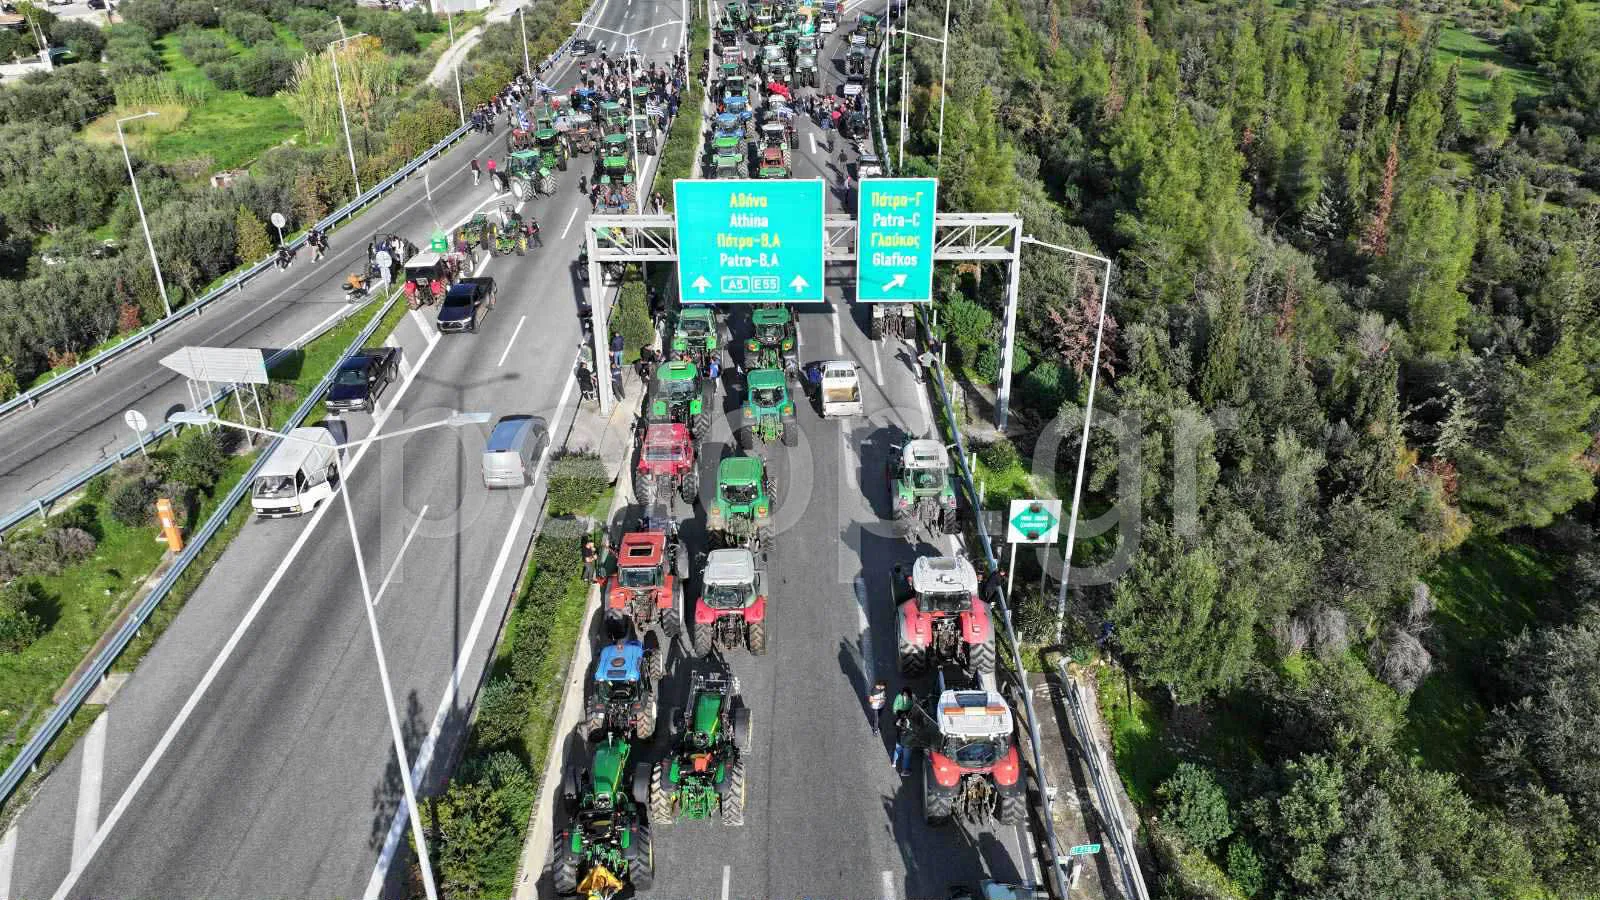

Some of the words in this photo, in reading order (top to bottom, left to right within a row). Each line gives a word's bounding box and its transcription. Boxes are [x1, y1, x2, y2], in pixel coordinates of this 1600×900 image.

[729, 192, 768, 208] Αθήνα
[729, 212, 769, 228] Athina
[872, 212, 921, 227] Patra-C
[870, 231, 921, 249] Γλαύκος
[872, 252, 918, 267] Glafkos
[728, 279, 743, 290] A5
